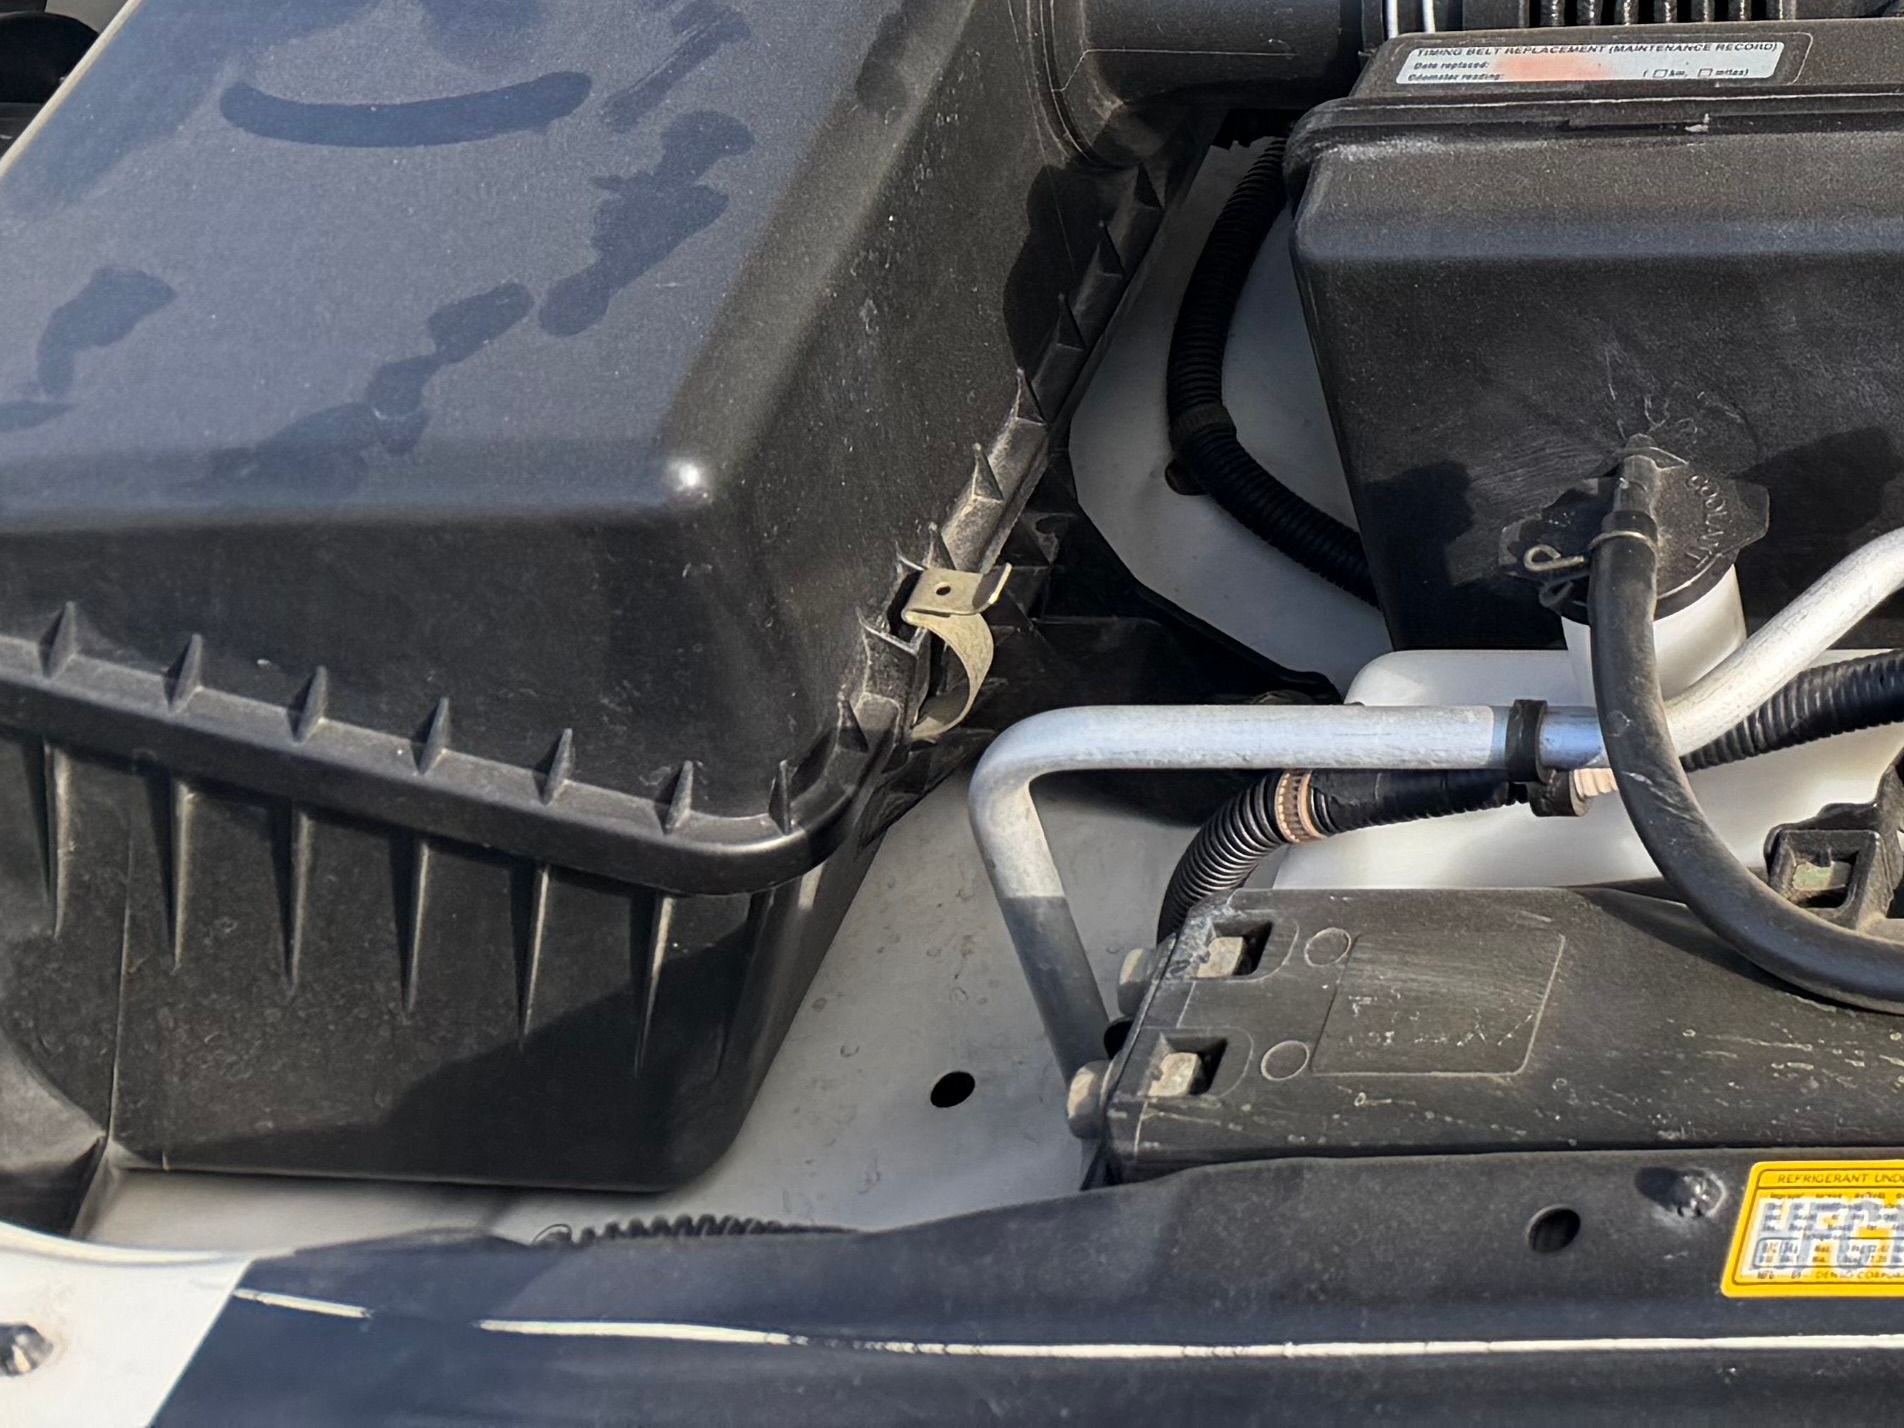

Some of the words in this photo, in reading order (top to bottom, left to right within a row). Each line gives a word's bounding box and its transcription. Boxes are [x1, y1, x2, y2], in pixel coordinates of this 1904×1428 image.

[1417, 48, 1464, 57] TIMING
[1466, 47, 1501, 56] BELT
[1504, 44, 1605, 54] REPLACEMENT
[1608, 43, 1713, 53] (MAINTENANCE
[1715, 42, 1779, 52] RECORD)
[1414, 62, 1438, 70] Date
[1439, 61, 1490, 71] replaced:
[1407, 73, 1460, 82] Odometer
[1460, 72, 1504, 82] reading:
[1776, 1172, 1872, 1185] REFRIGERANT
